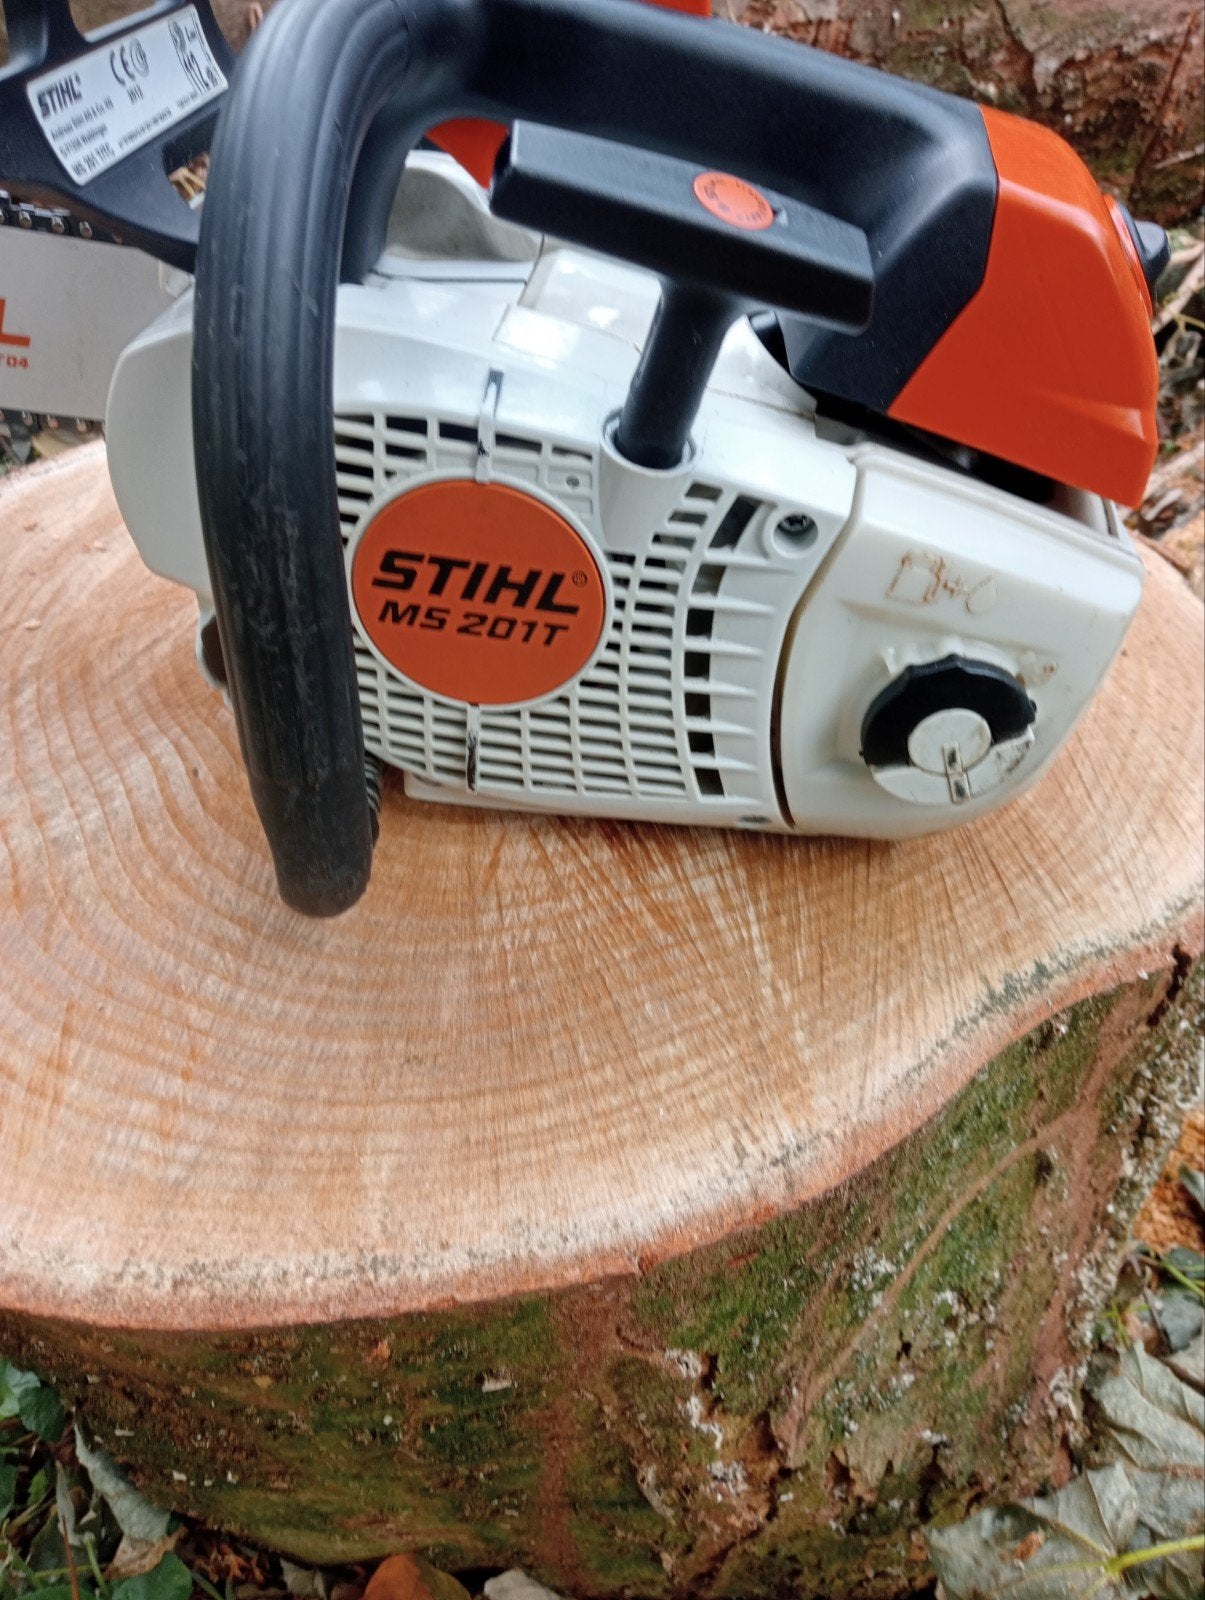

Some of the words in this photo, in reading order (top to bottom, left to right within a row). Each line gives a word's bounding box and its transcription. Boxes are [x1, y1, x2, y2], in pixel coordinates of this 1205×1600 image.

[37, 75, 82, 120] STIHL
[372, 550, 580, 617] STIHL
[378, 600, 451, 632] MS
[456, 612, 570, 647] 201T
